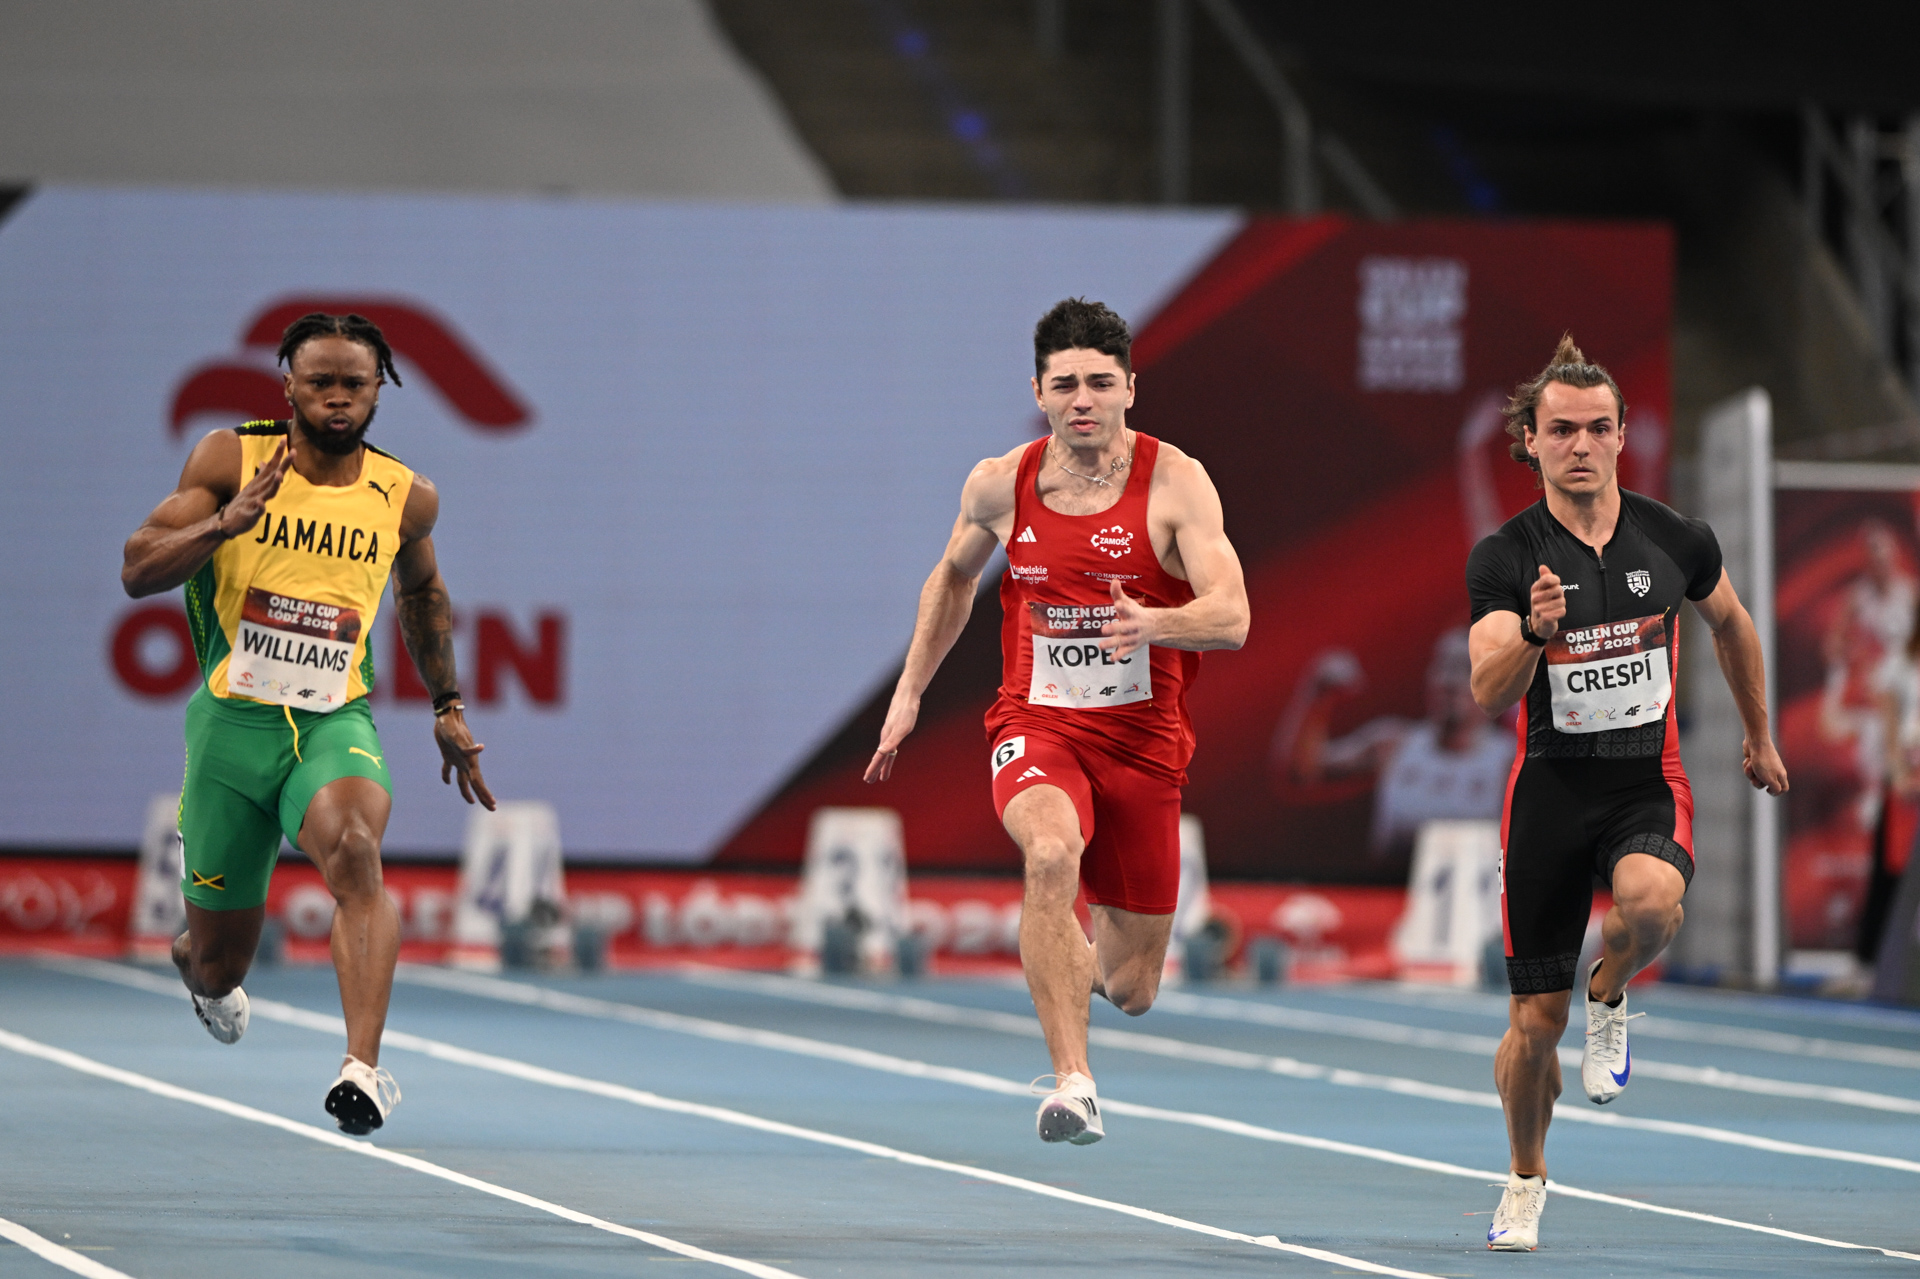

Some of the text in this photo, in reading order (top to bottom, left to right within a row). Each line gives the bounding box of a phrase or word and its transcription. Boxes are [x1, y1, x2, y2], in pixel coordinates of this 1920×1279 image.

[255, 512, 379, 564] JAMAICA
[1100, 536, 1130, 546] ZAMOŚĆ
[269, 595, 340, 619] ORLEN CUP
[1046, 606, 1090, 618] ORLEN
[267, 608, 338, 631] ŁÓDŹ 2026
[1048, 619, 1079, 629] ŁÓDŹ
[1565, 622, 1639, 643] ORLEN CUP
[243, 628, 349, 673] WILLIAMS
[1568, 635, 1641, 655] ŁÓDŹ 2026
[1567, 652, 1652, 693] CRESPÍ
[297, 688, 317, 699] 4F
[1099, 686, 1118, 696] 4F
[1625, 704, 1641, 716] 4F
[996, 742, 1015, 767] 6
